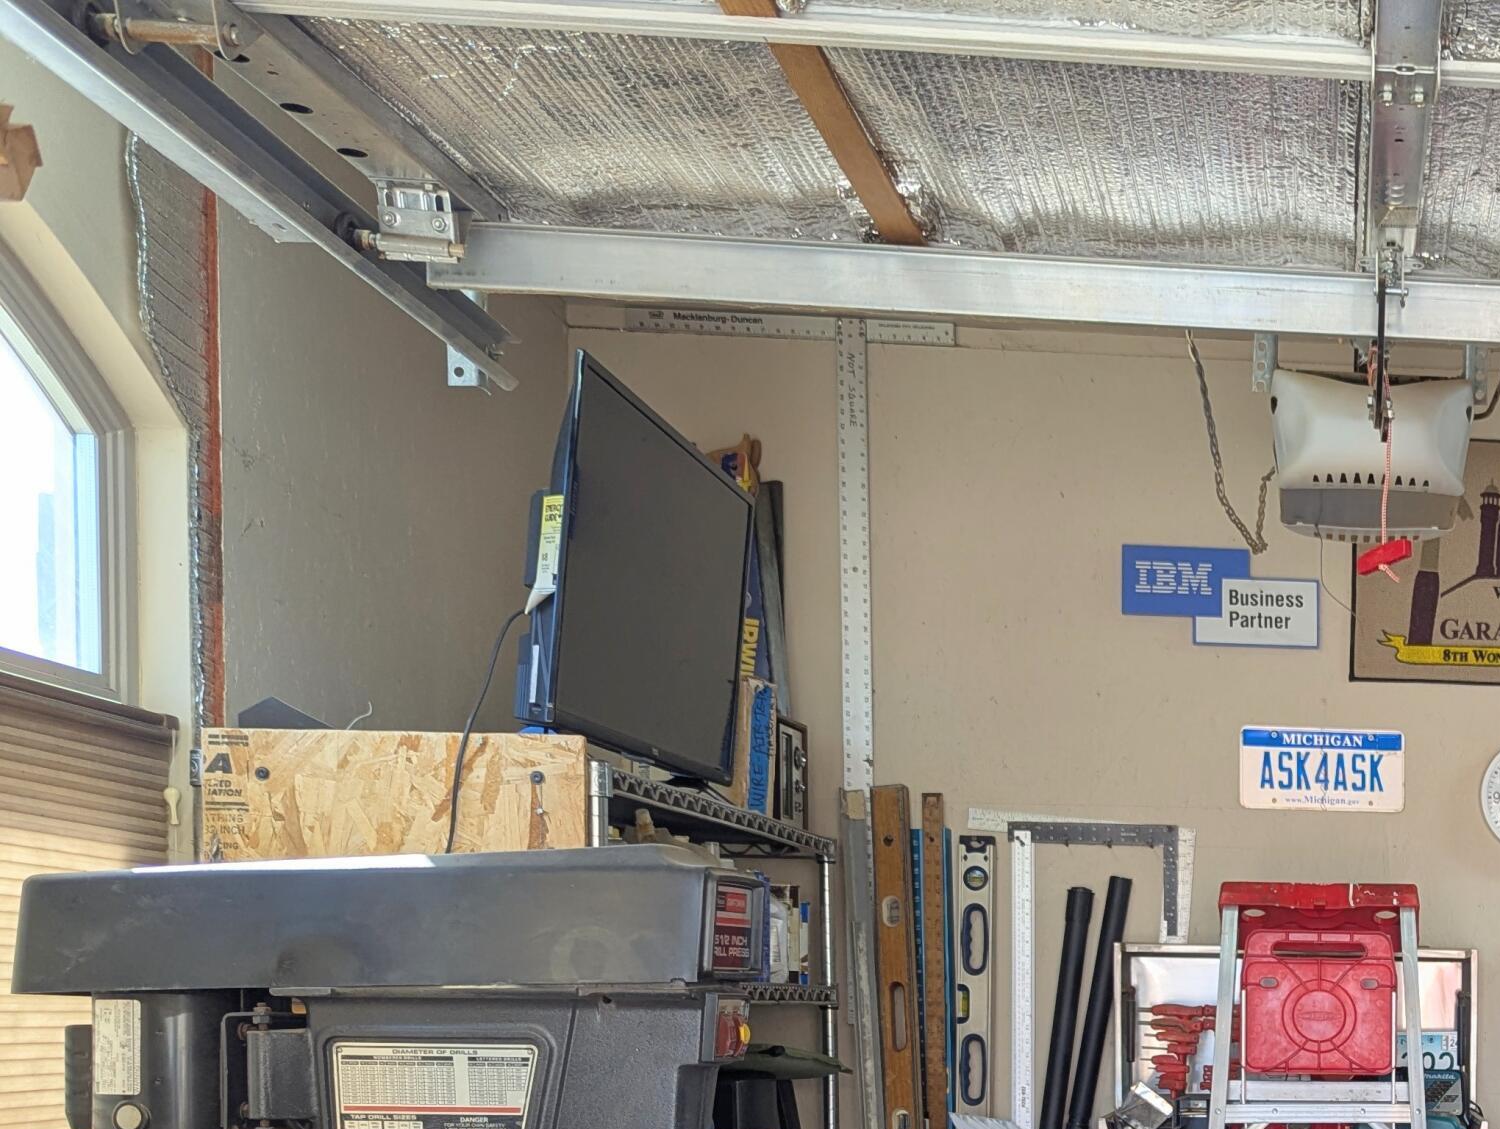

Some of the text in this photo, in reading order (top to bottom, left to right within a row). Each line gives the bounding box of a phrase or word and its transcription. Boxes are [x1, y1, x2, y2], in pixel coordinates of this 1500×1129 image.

[1135, 560, 1213, 596] IBM
[1229, 588, 1304, 608] Business
[1229, 610, 1291, 630] Partner
[740, 617, 760, 677] IRWI
[1442, 650, 1469, 663] 8TH
[1283, 733, 1363, 748] MICHIGAN
[1260, 751, 1384, 793] ASK4ASK
[1493, 791, 1500, 804] 9
[732, 935, 747, 946] INCH
[728, 947, 750, 958] PRESS
